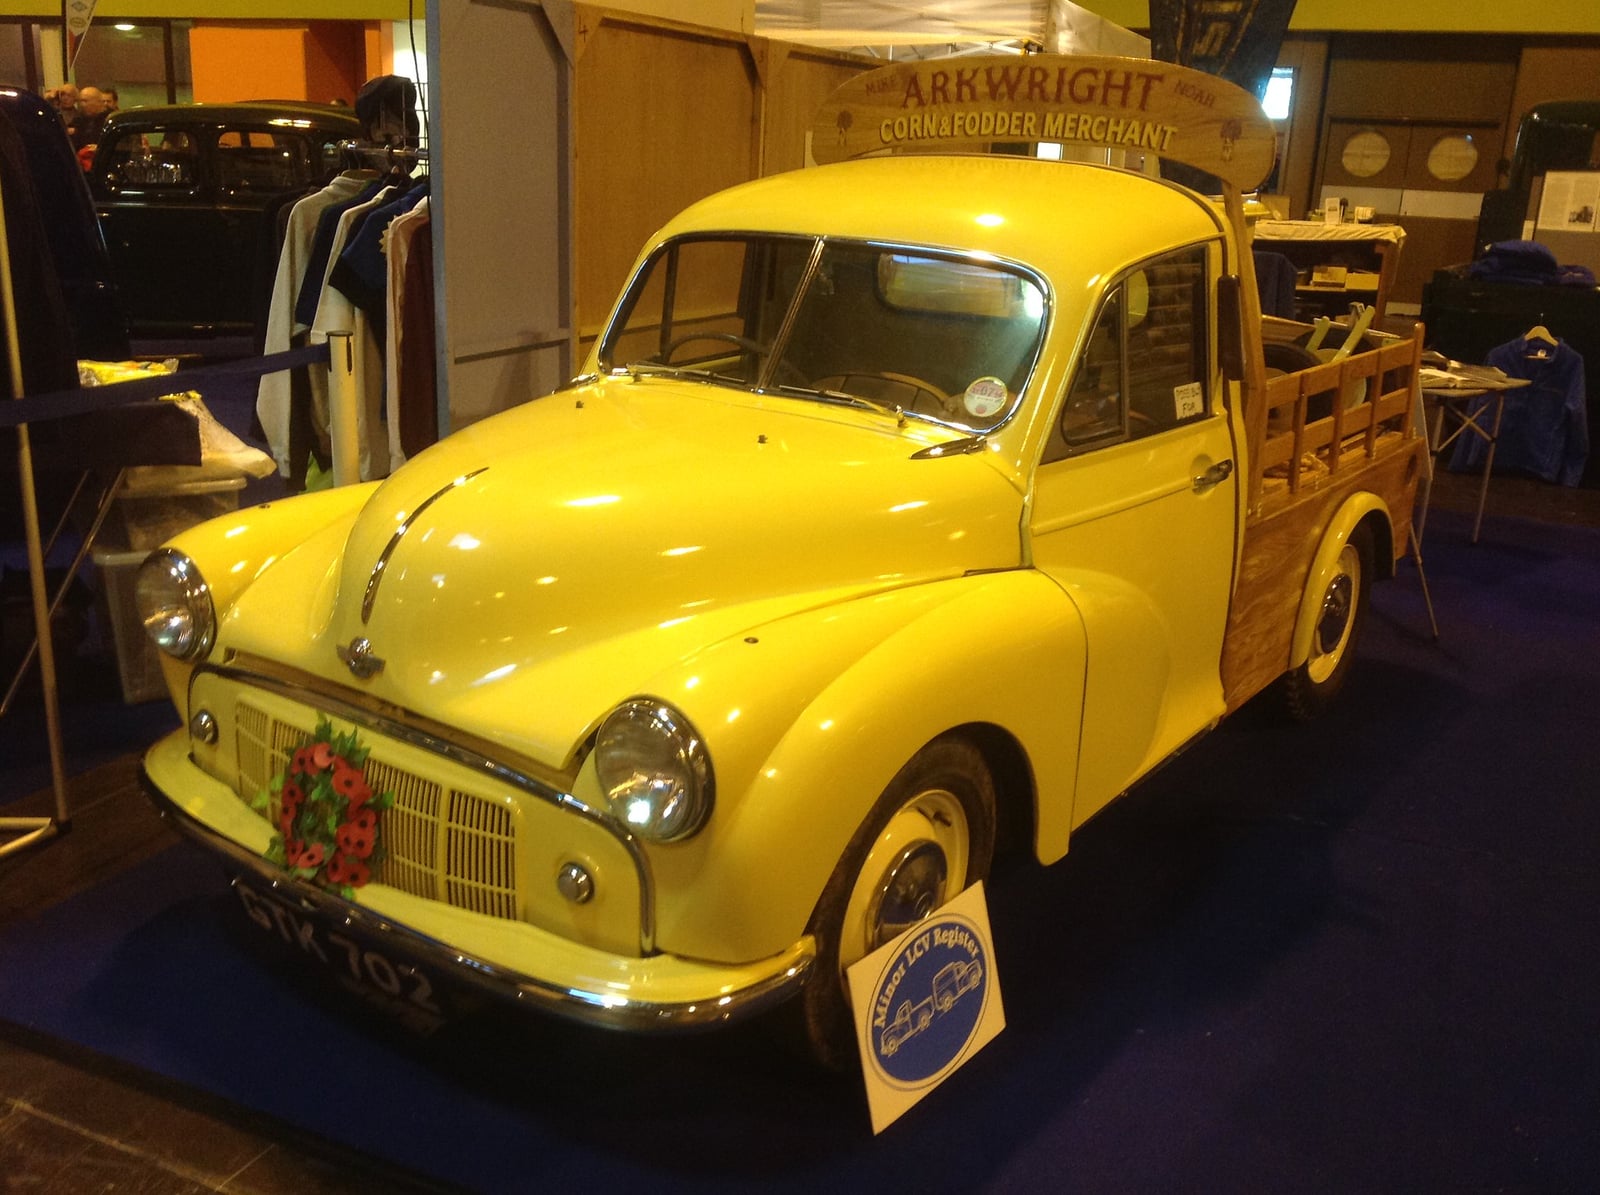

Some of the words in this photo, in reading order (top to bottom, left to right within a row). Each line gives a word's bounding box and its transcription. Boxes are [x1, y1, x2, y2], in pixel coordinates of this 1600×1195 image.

[901, 65, 1165, 112] ARKWRIGHT
[1043, 112, 1179, 151] MERCHANT
[328, 932, 442, 1014] 702
[873, 962, 907, 1029] Minor
[904, 931, 931, 967] LCV
[933, 925, 980, 959] Register
